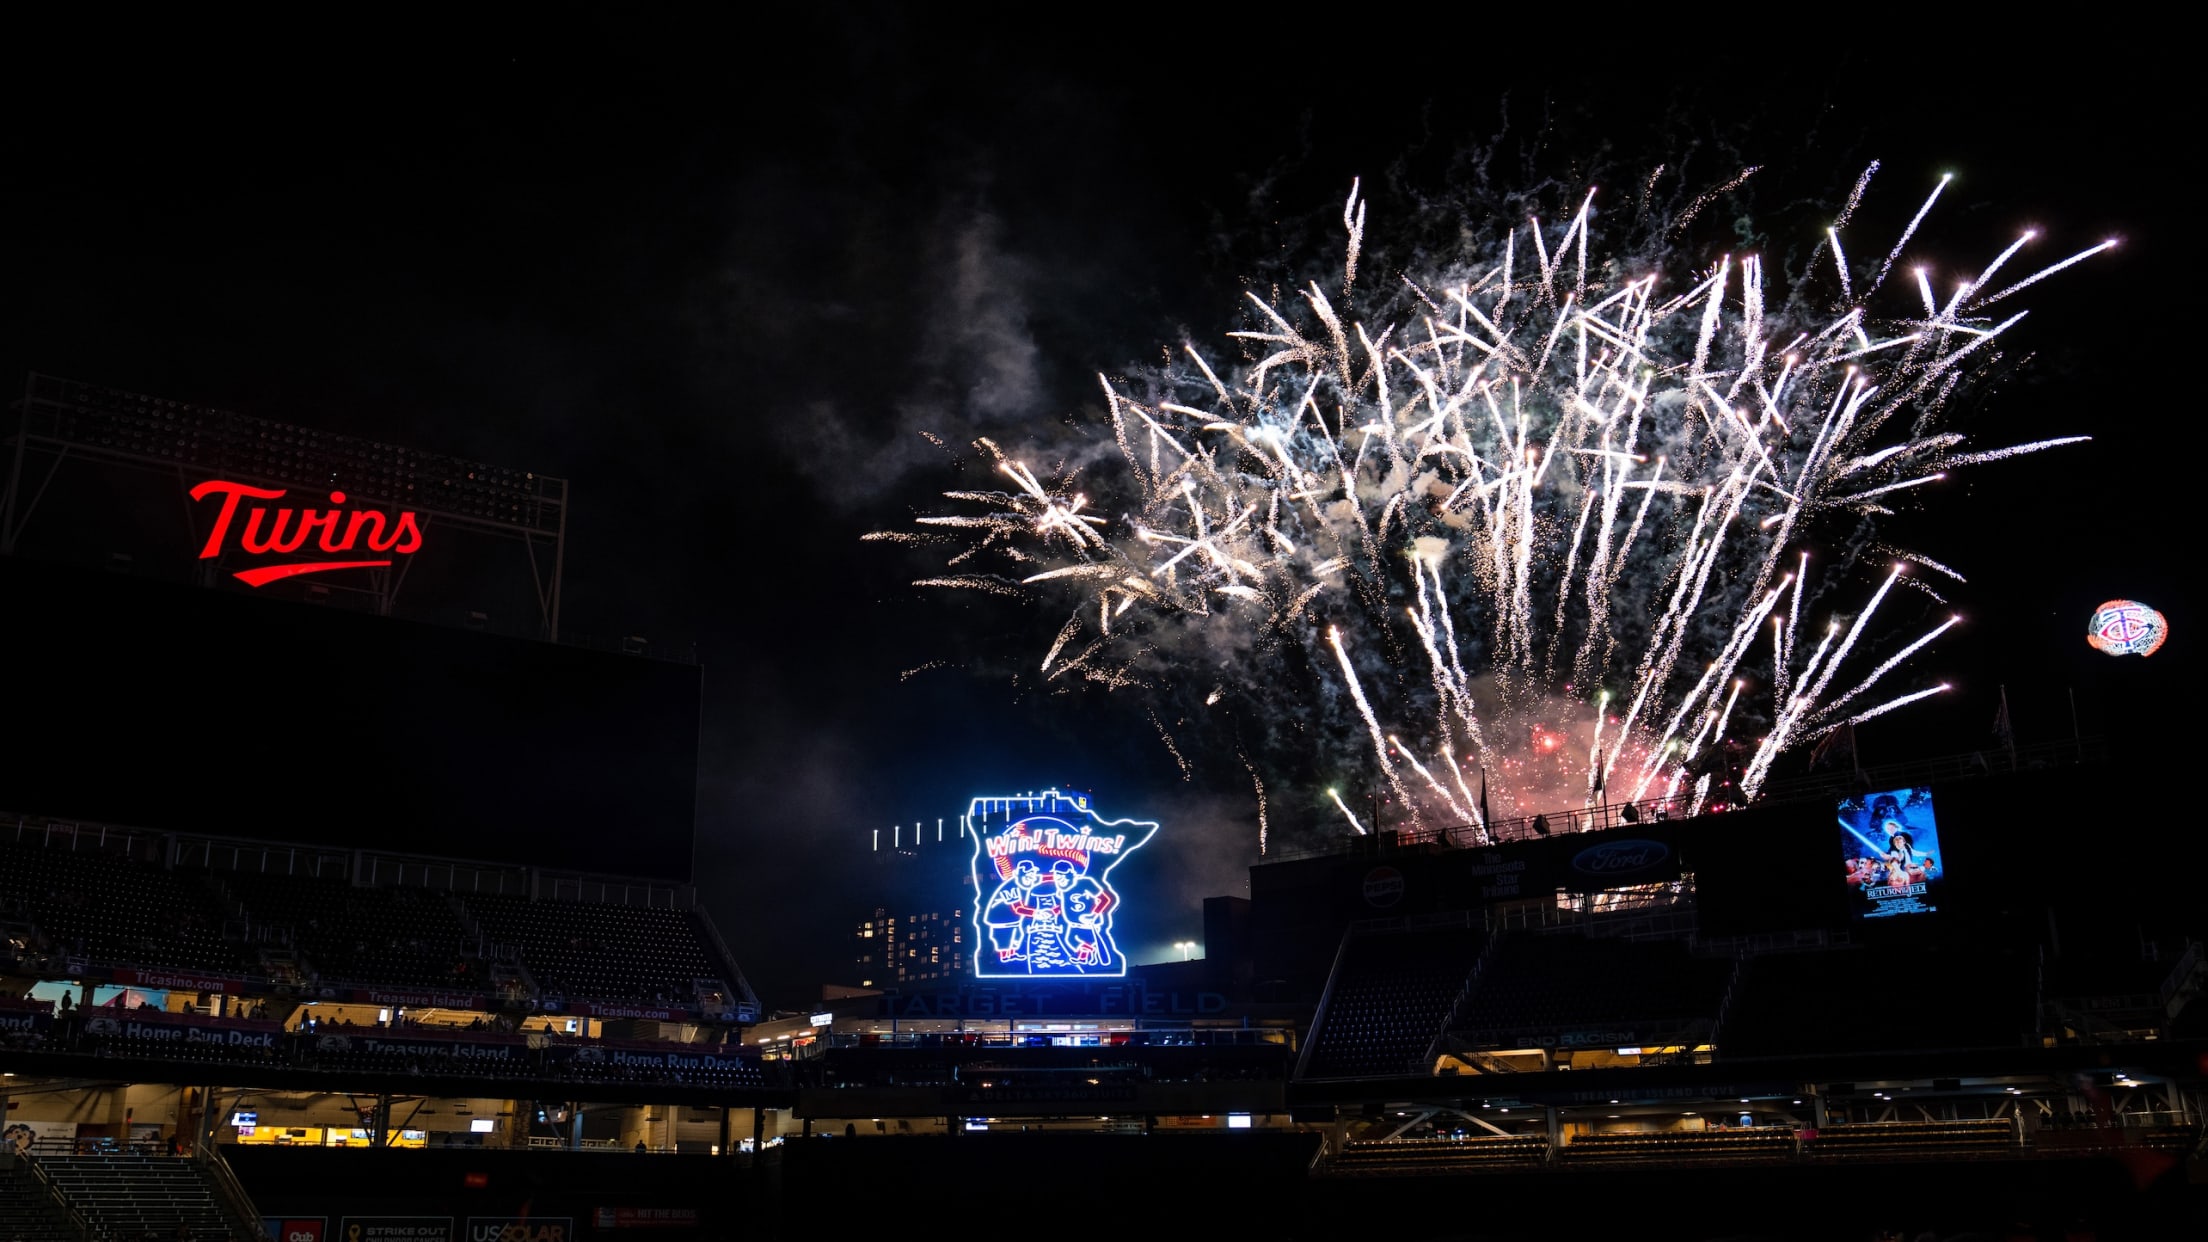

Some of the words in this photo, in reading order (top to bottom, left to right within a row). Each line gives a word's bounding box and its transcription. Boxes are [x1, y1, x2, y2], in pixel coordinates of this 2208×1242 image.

[189, 480, 422, 559] Twins
[986, 828, 1043, 858] Win!
[1045, 826, 1125, 855] Twins!
[1482, 852, 1502, 864] The
[1592, 848, 1649, 870] Ford
[1472, 860, 1527, 877] Minnesota
[1366, 880, 1402, 893] PEPSI
[1495, 873, 1520, 886] Star
[1481, 884, 1520, 897] Tribune
[369, 991, 429, 1006] Treasure
[432, 994, 473, 1008] Island
[880, 991, 1054, 1015] TARGET
[1098, 990, 1227, 1015] FIELD
[126, 1022, 182, 1040] Home
[228, 1030, 273, 1047] Deck
[1517, 1035, 1556, 1048] END
[1560, 1031, 1636, 1046] RACISM
[613, 1051, 663, 1066] Home
[667, 1053, 700, 1068] Run
[704, 1055, 745, 1069] Deck
[1572, 1088, 1637, 1101] TREASURE
[1646, 1087, 1693, 1098] ISLAND
[1701, 1086, 1736, 1096] COVE
[289, 1231, 315, 1242] Cub
[366, 1226, 415, 1237] STRIKE
[417, 1226, 447, 1237] OUT
